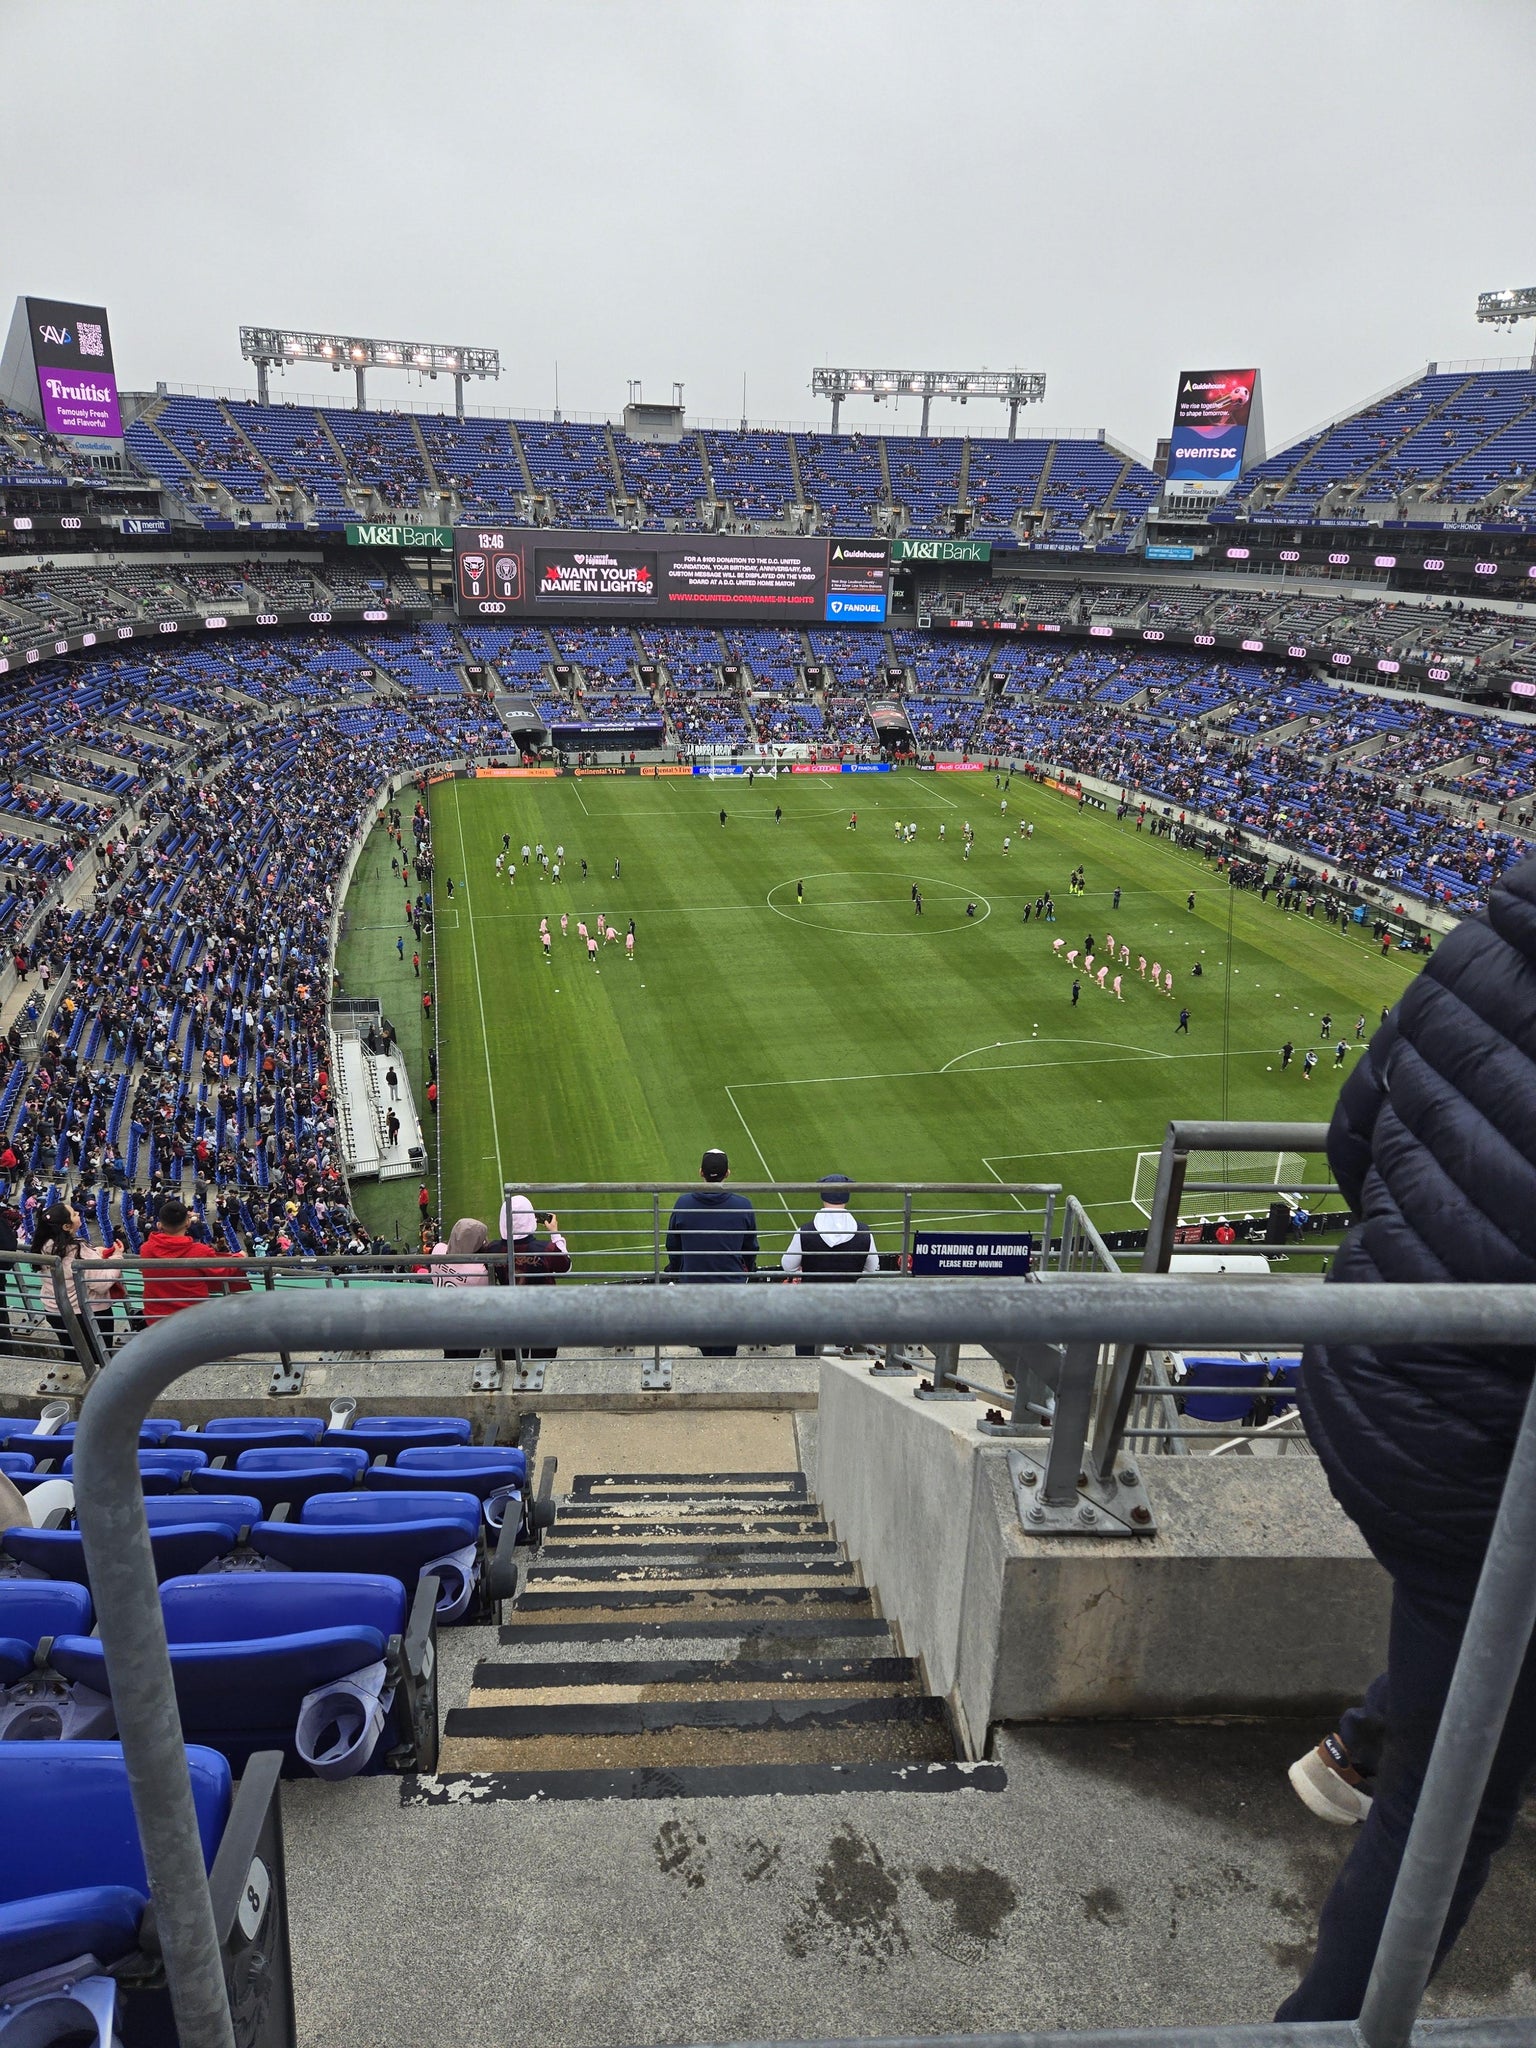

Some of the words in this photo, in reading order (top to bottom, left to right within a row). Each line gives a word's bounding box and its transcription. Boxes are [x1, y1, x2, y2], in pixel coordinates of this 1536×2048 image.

[46, 379, 111, 402] Fruitist
[57, 406, 89, 419] Famously
[89, 409, 109, 419] Fresh
[63, 418, 75, 426] and
[77, 418, 106, 428] Flavorful
[75, 441, 113, 451] Constellation
[142, 521, 166, 530] merritt
[1461, 523, 1482, 531] HONOR
[357, 525, 402, 545] M&T
[403, 527, 445, 546] Bank
[478, 533, 504, 549] 13:46
[843, 550, 886, 559] Guidehouse
[901, 541, 943, 559] M&T
[943, 543, 981, 560] Bank
[673, 563, 712, 571] FOUNDATION,
[557, 566, 597, 580] WANT
[600, 568, 638, 581] YOUR
[472, 581, 480, 596] 0
[504, 581, 511, 596] 0
[541, 579, 582, 593] NAME
[584, 581, 598, 592] IN
[600, 581, 653, 594] LIGHTS?
[844, 604, 881, 612] FANDUEL
[574, 767, 608, 776] Continental
[612, 767, 626, 775] Tire
[916, 1244, 929, 1255] NO
[931, 1244, 974, 1256] STANDING
[976, 1245, 989, 1256] ON
[990, 1245, 1029, 1256] LANDING
[939, 1260, 961, 1268] PLEASE
[962, 1260, 978, 1268] KEEP
[979, 1260, 1003, 1269] MOVING
[247, 1885, 260, 1913] 8
